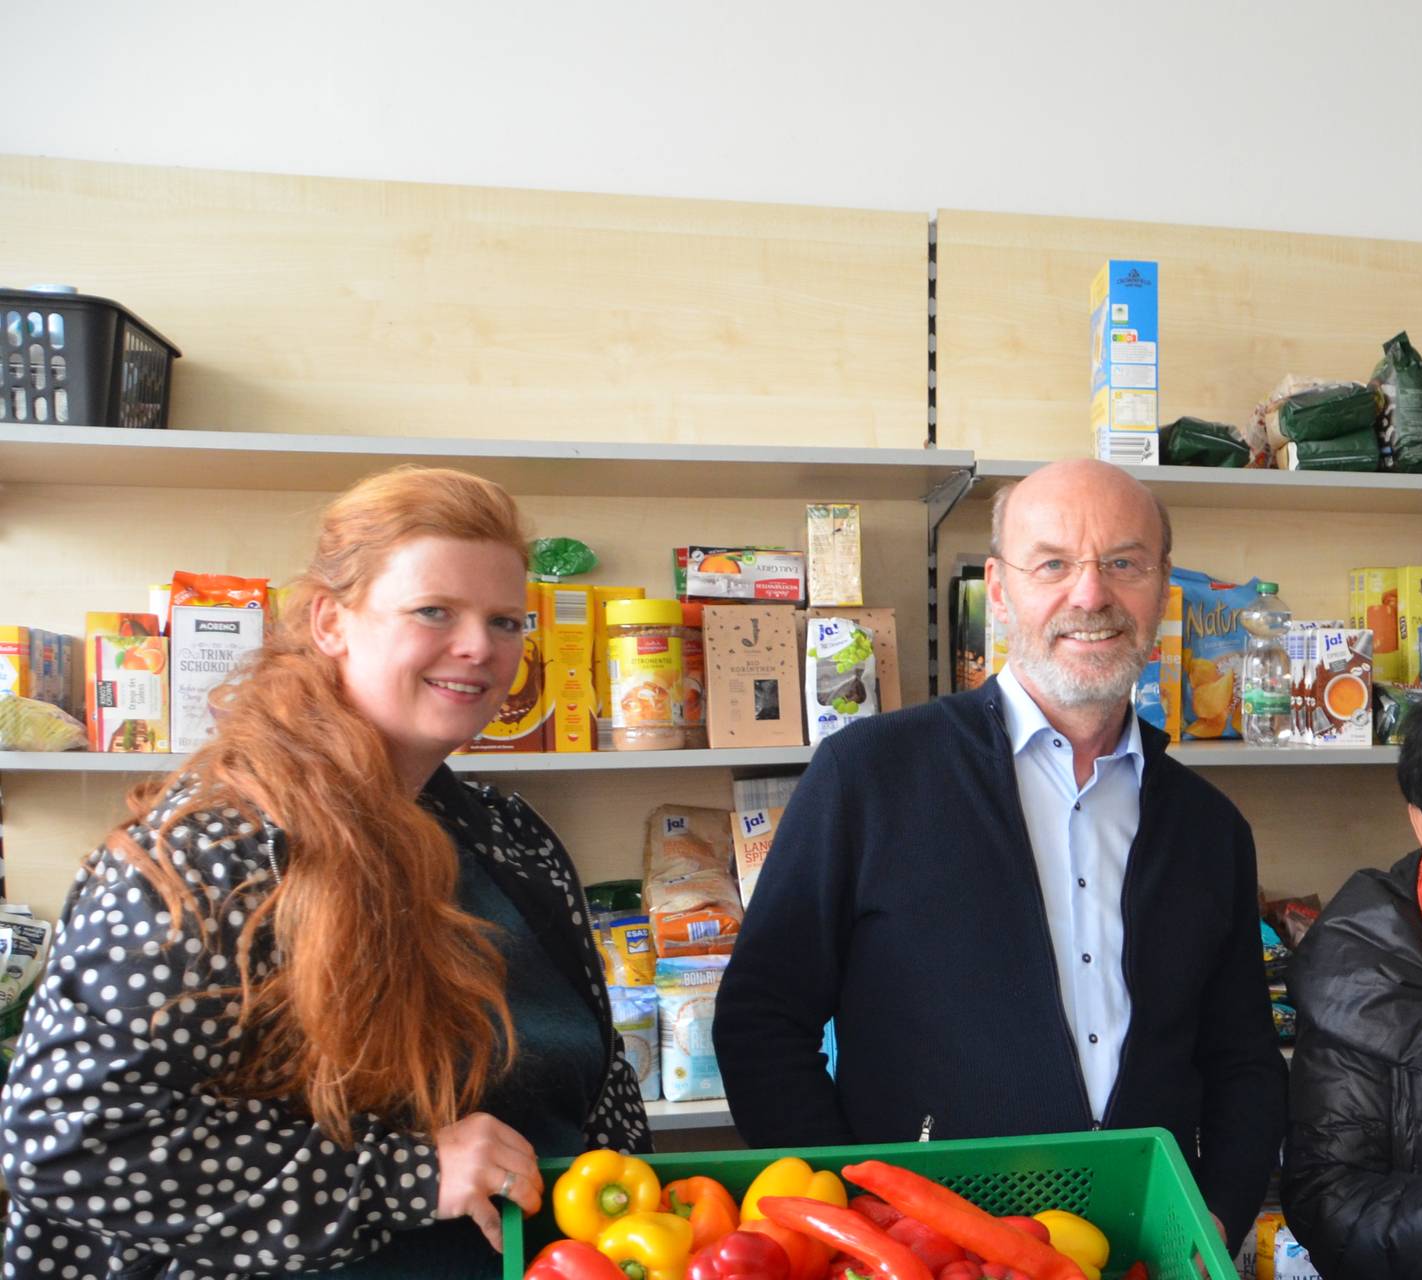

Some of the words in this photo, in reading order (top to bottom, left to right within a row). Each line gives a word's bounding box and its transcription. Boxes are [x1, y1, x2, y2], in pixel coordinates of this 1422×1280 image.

[1185, 600, 1242, 641] Natur
[818, 623, 839, 641] ja!
[1324, 632, 1343, 652] ja!
[199, 648, 233, 661] TRINK
[180, 659, 246, 674] SCHOKOLA
[666, 817, 685, 832] ja!
[743, 812, 766, 833] ja!
